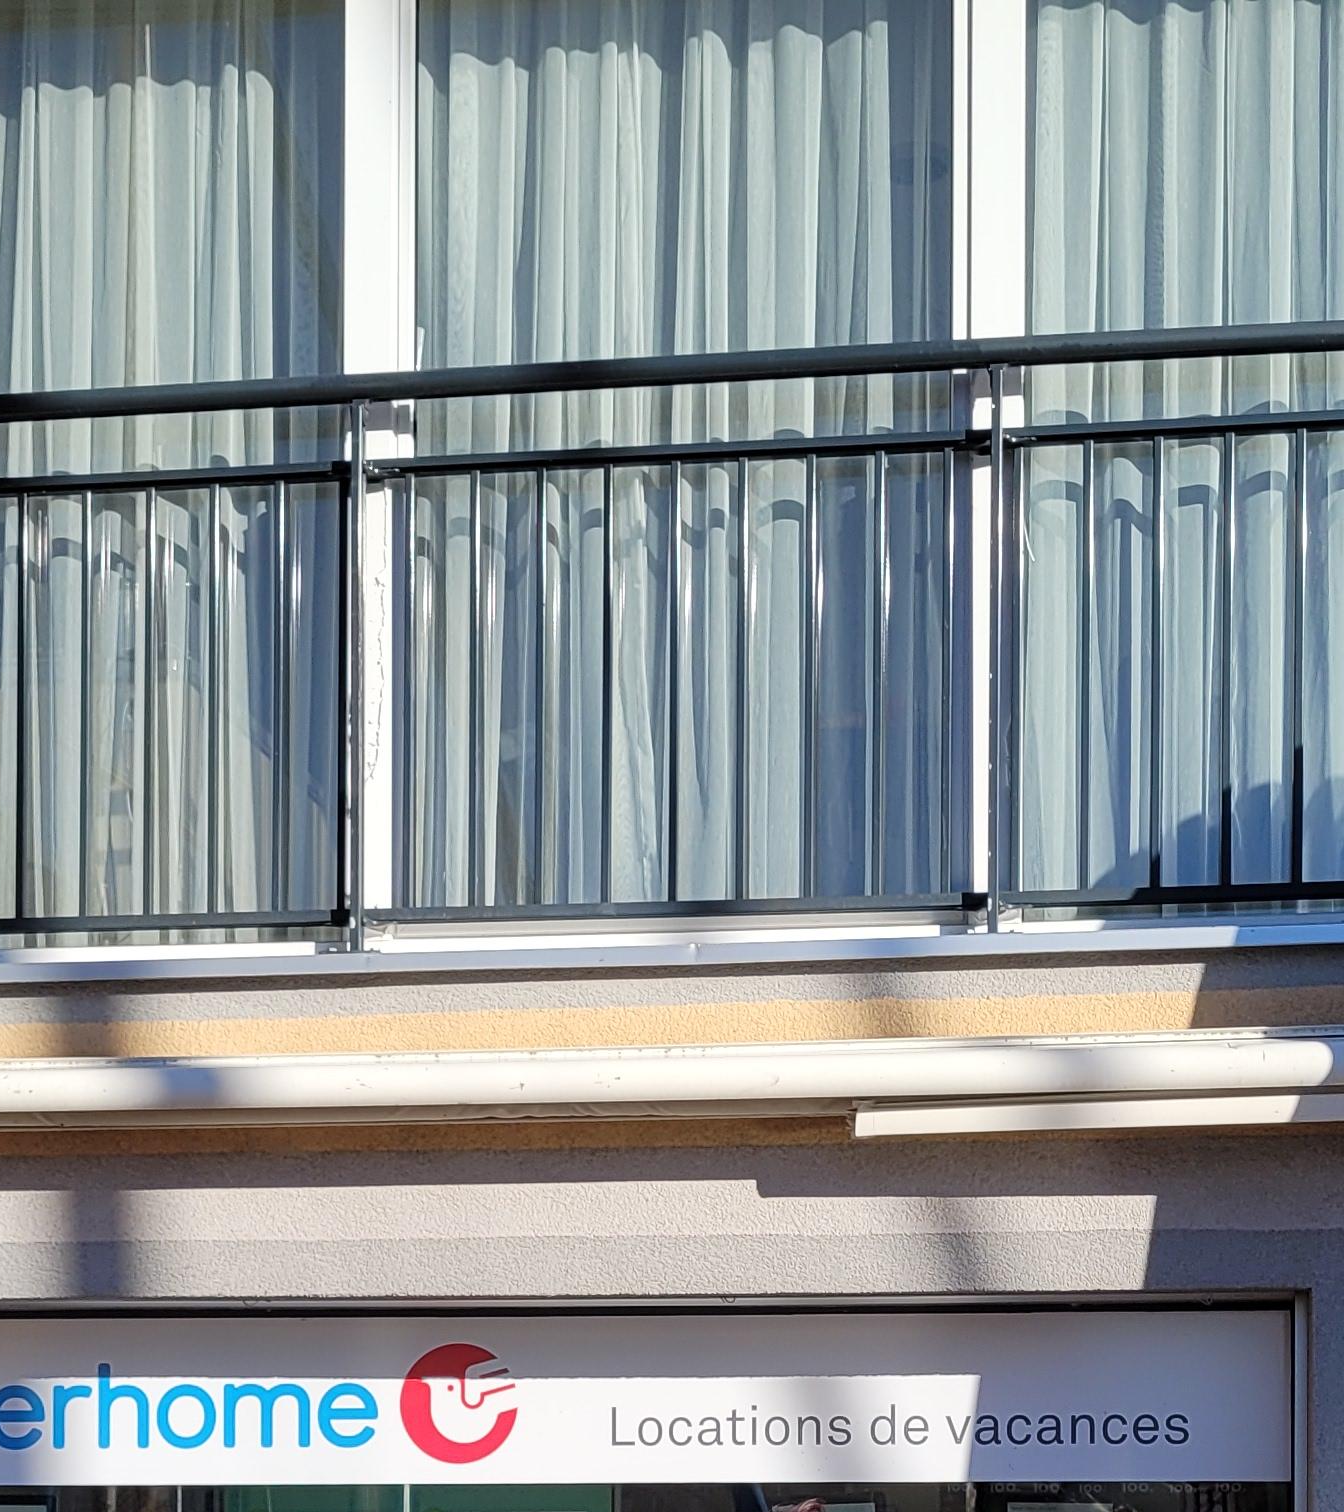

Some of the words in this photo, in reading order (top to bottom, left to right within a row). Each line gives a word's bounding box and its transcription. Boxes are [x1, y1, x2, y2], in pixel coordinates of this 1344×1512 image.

[611, 1405, 852, 1448] Locations
[870, 1404, 930, 1448] de
[947, 1412, 1190, 1447] vacances
